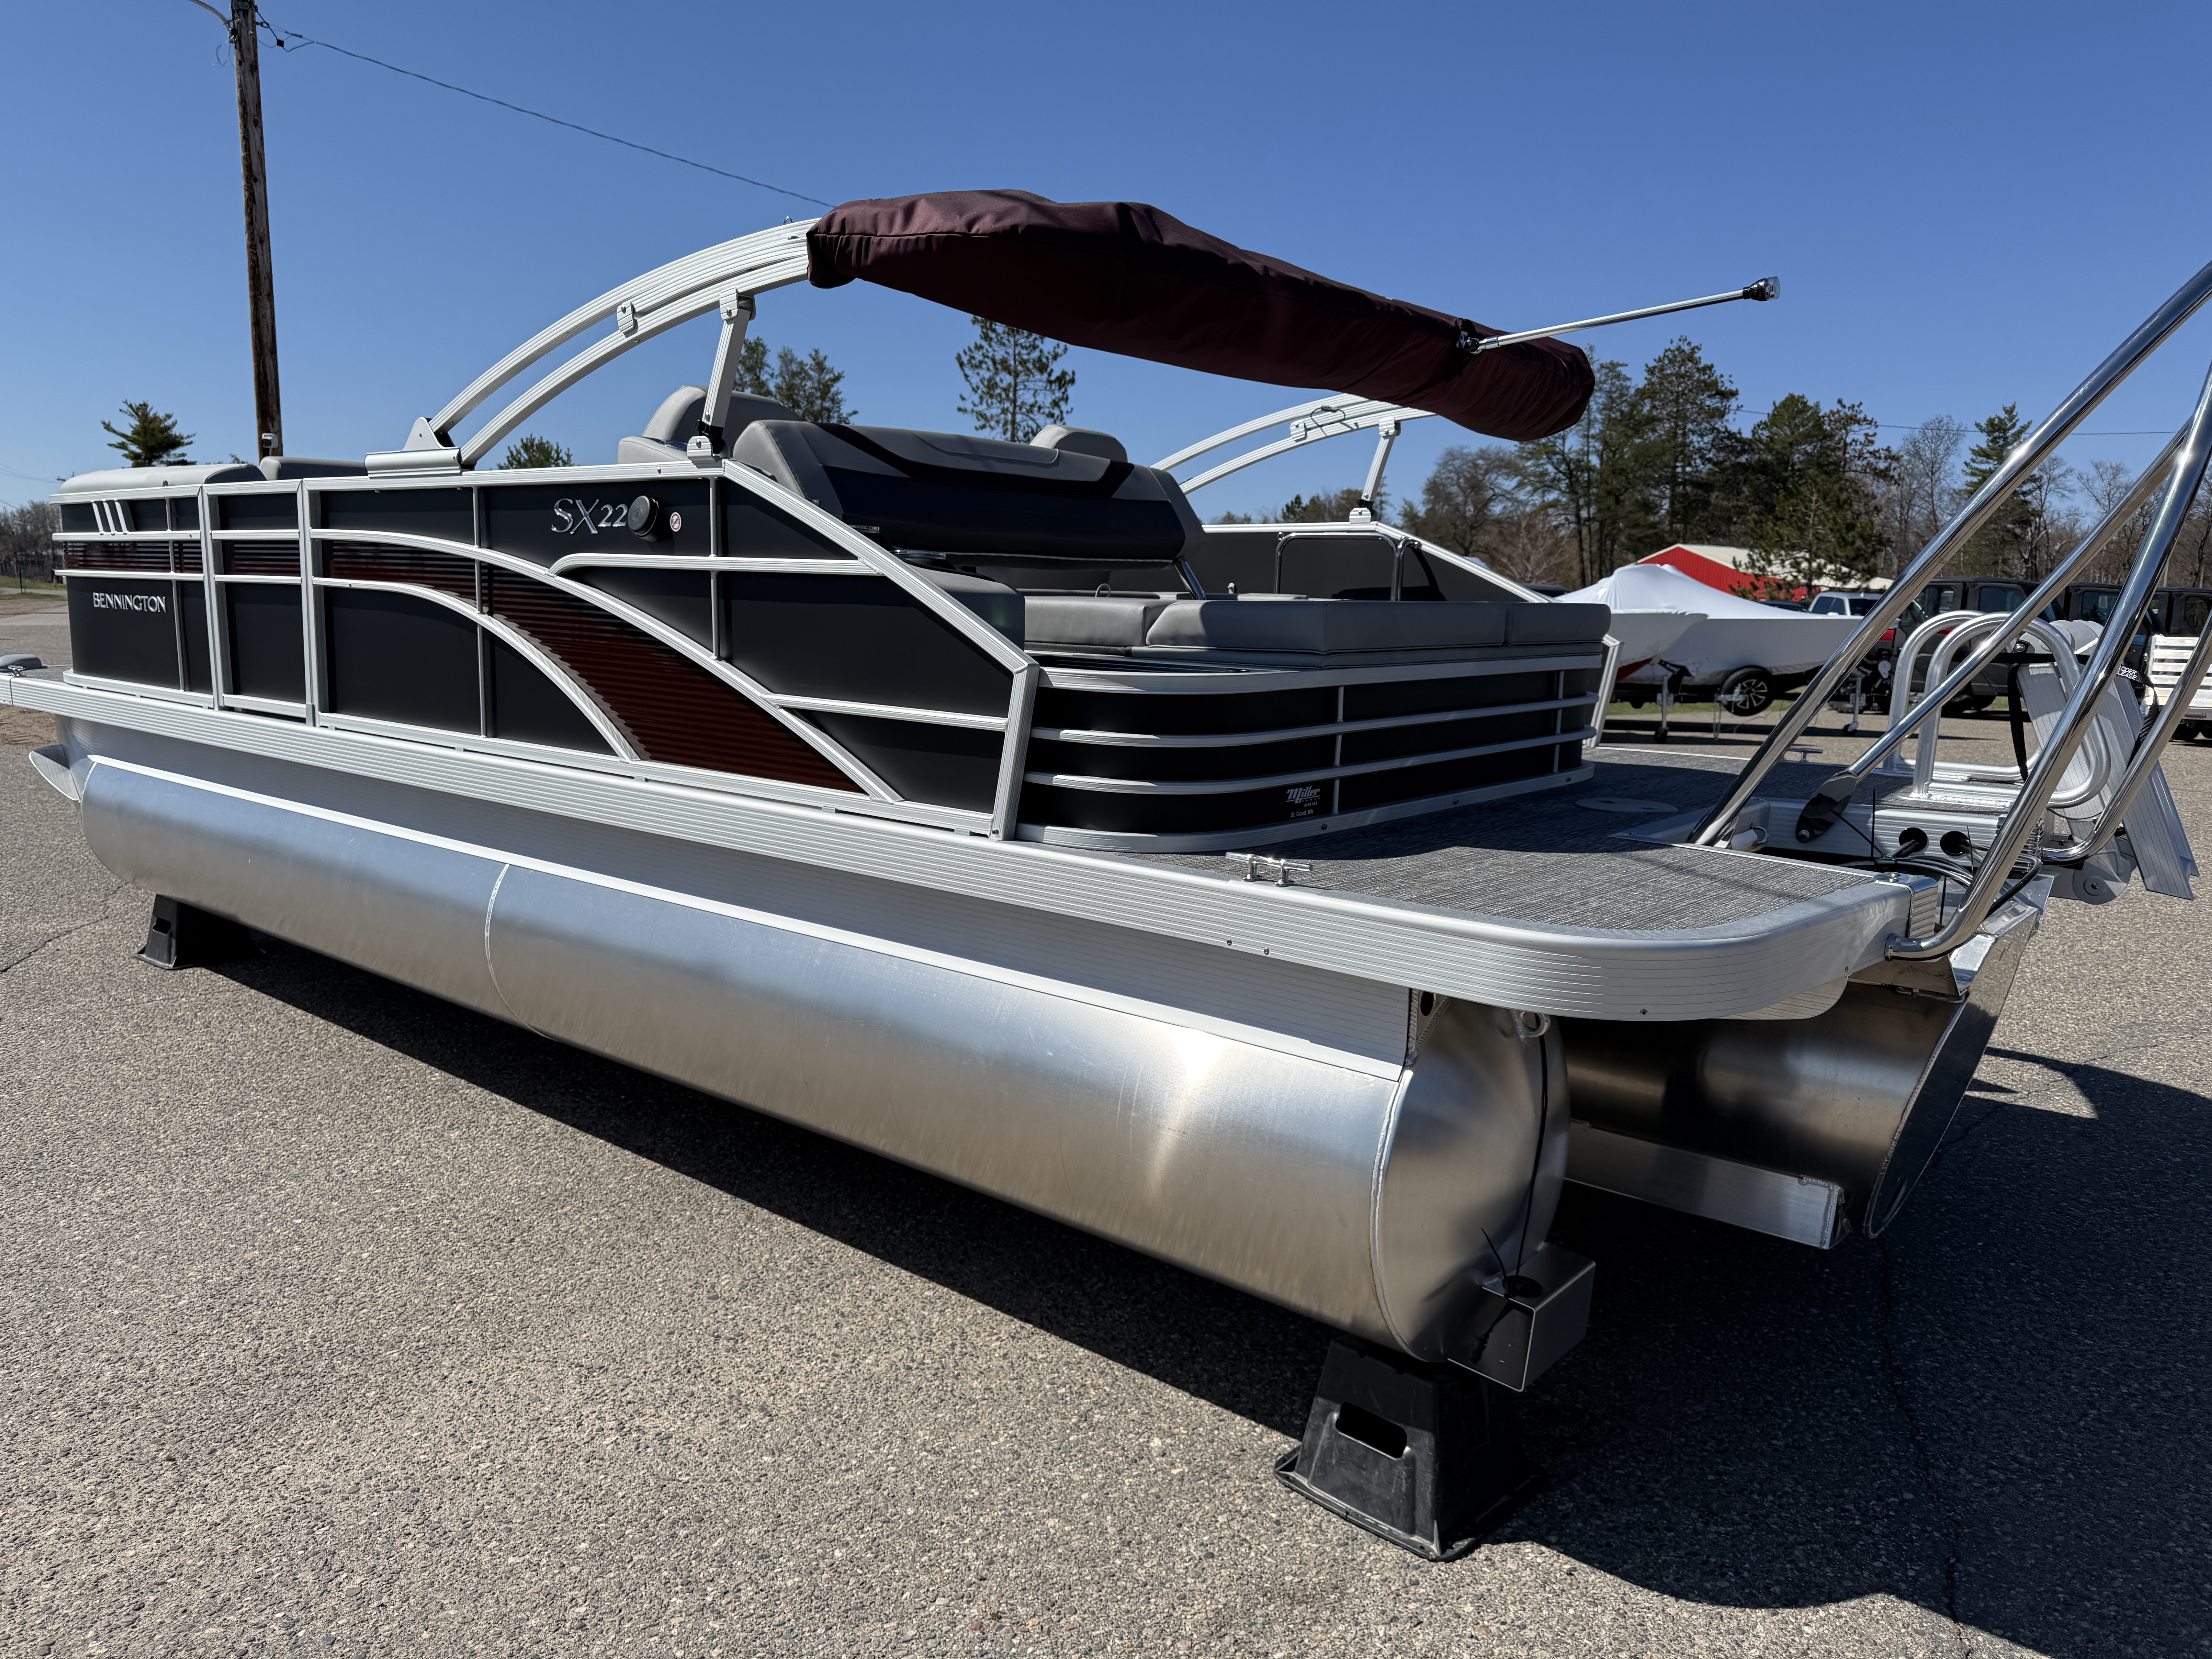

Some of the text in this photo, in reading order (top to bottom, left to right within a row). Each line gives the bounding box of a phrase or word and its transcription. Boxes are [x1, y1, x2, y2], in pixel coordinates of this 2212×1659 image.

[551, 498, 628, 534] SX22
[93, 592, 166, 613] BENNINGTON
[1286, 786, 1320, 804] Miller
